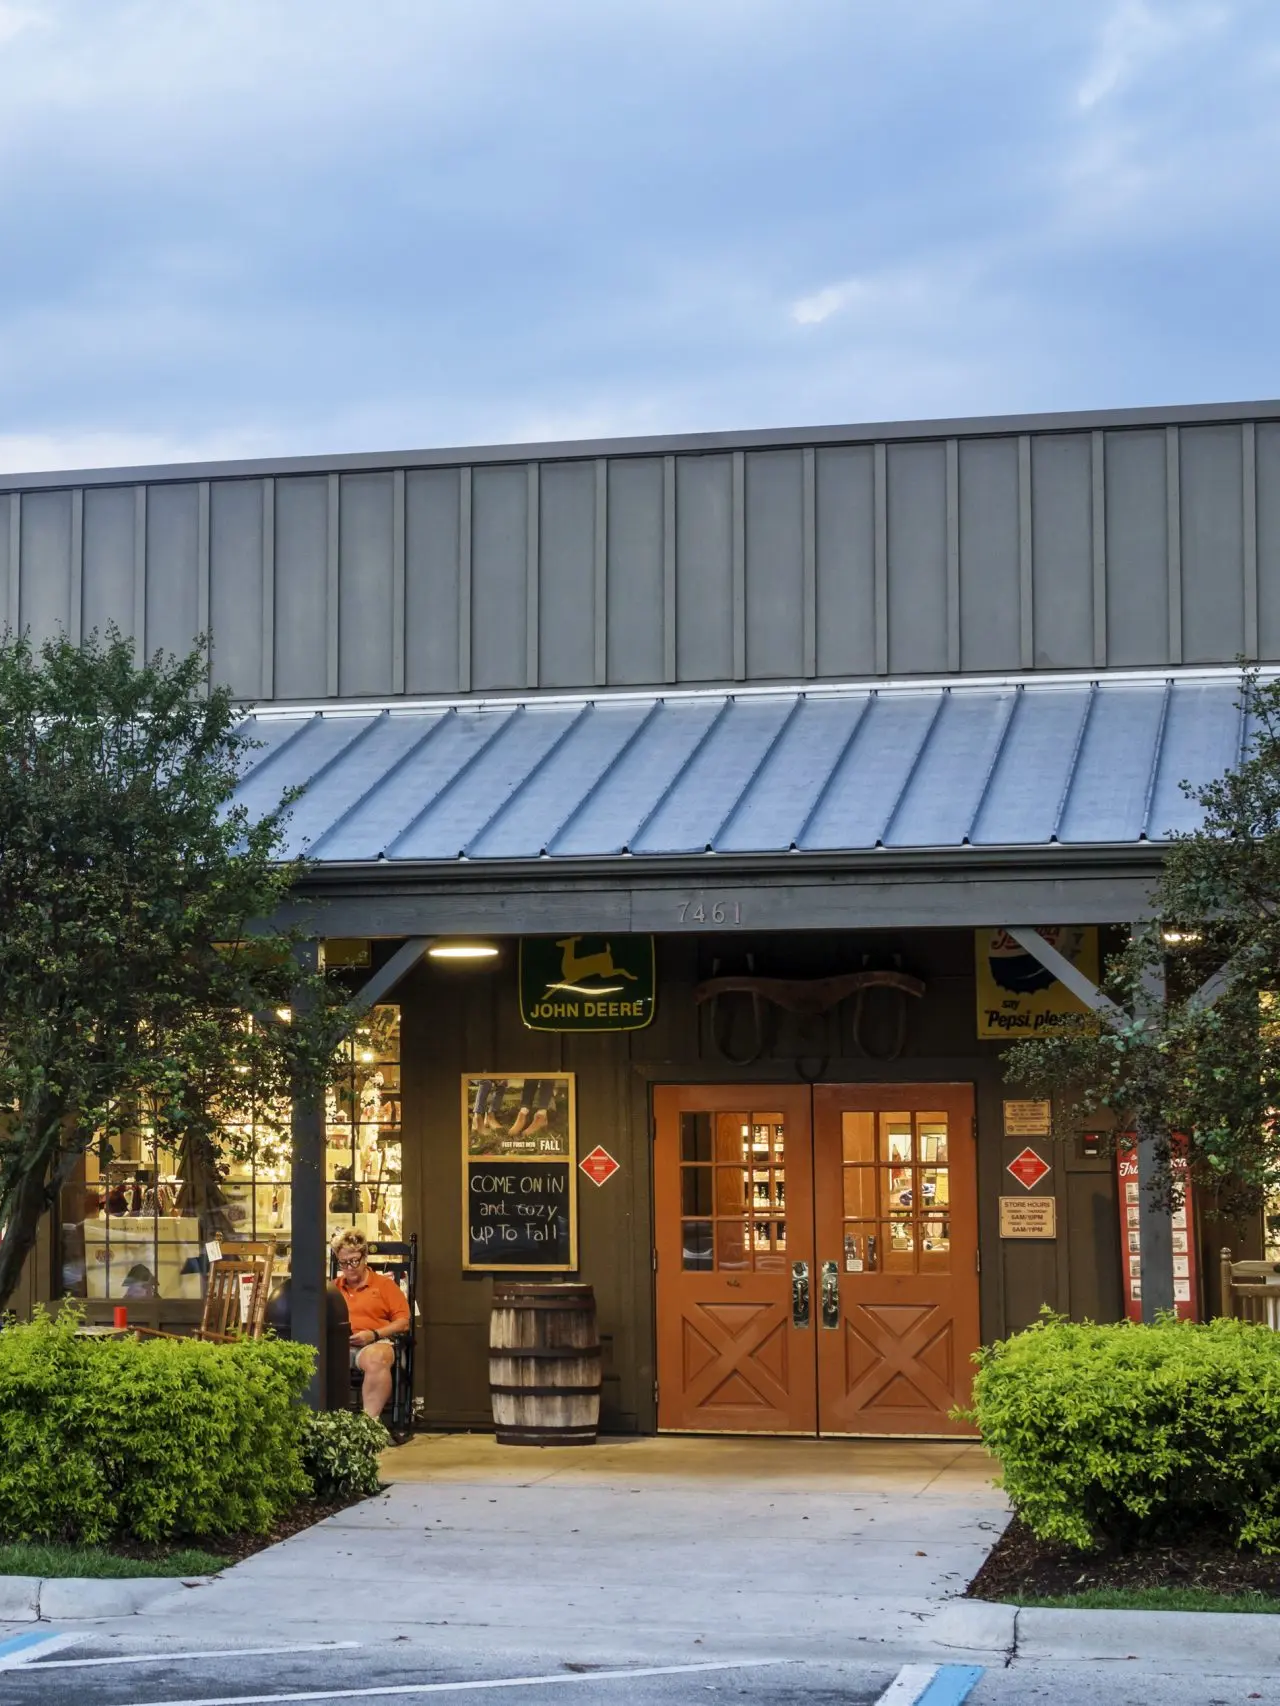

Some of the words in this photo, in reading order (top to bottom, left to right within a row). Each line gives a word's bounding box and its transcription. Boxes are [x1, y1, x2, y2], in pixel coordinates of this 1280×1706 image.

[677, 901, 743, 924] 7461
[530, 1002, 579, 1018] JOHN
[584, 1001, 643, 1017] DEERE
[540, 1140, 561, 1151] FALL
[470, 1175, 517, 1194] COME
[520, 1176, 542, 1193] ON
[480, 1200, 510, 1216] and
